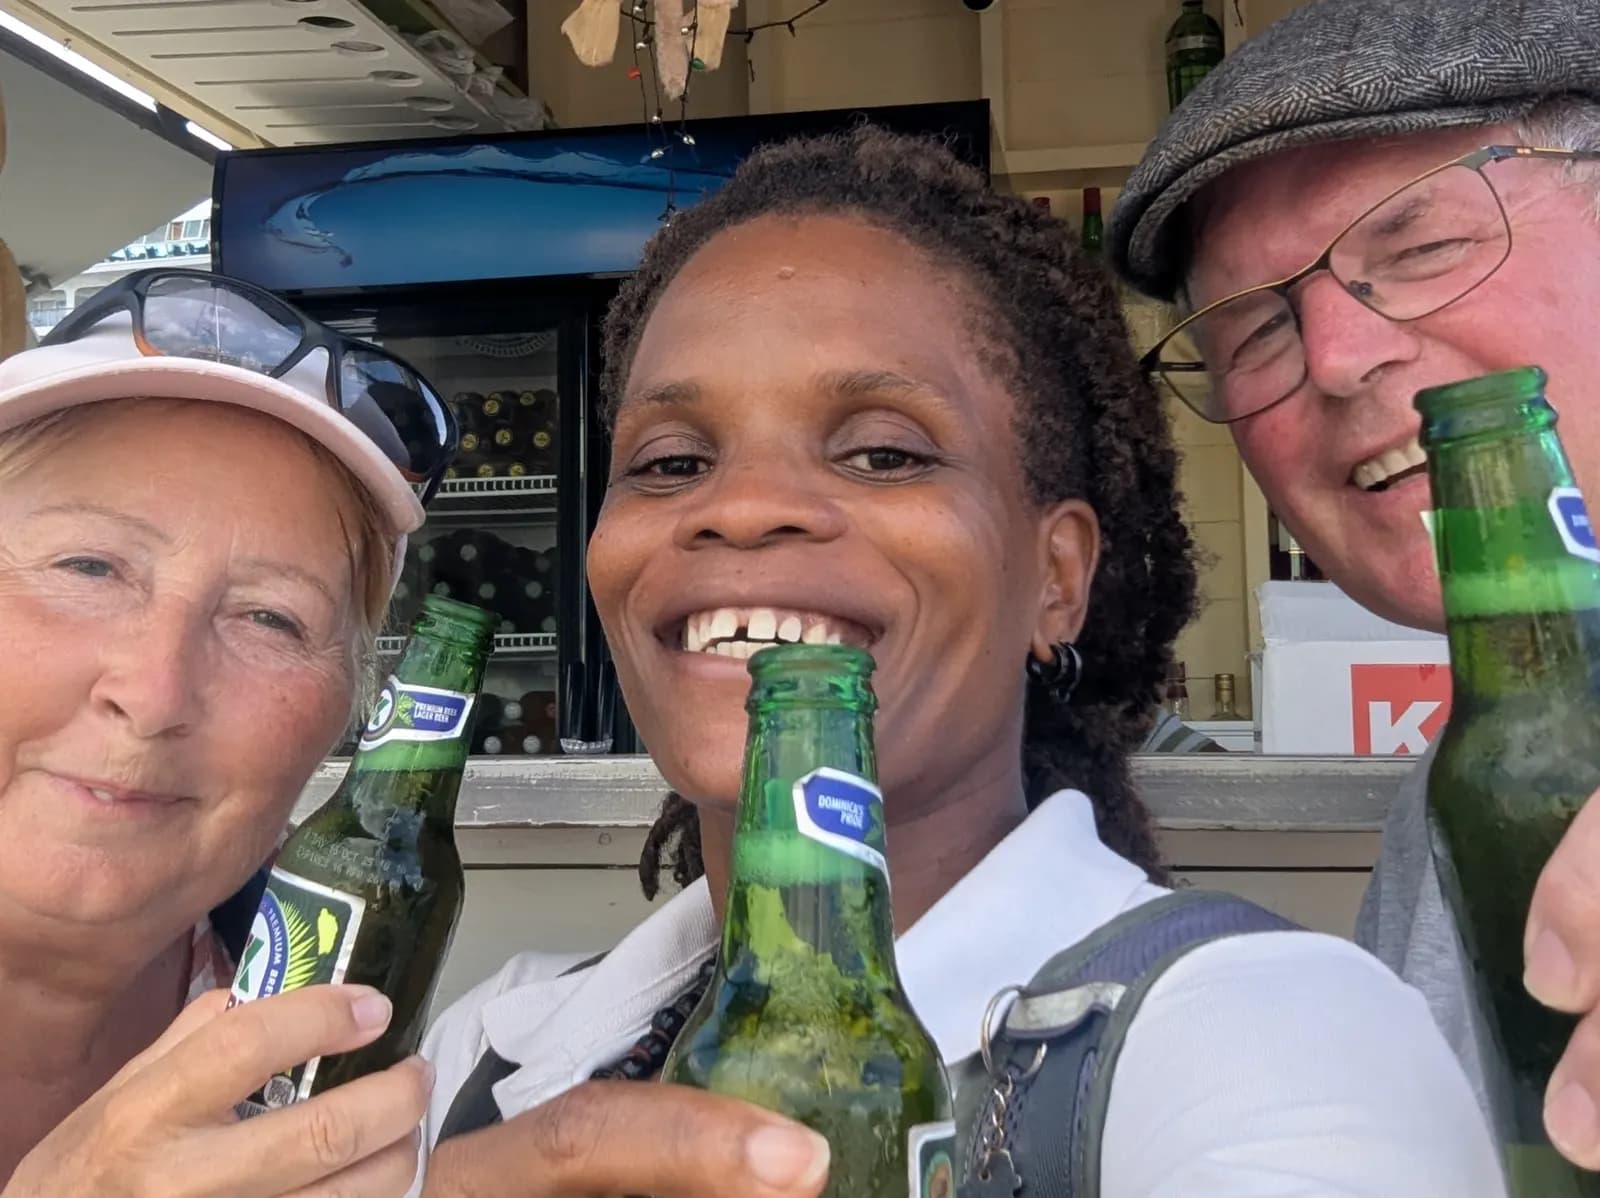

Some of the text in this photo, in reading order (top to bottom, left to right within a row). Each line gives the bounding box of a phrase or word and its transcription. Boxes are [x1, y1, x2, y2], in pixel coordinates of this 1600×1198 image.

[413, 708, 434, 721] LAGER
[1368, 701, 1442, 755] K
[818, 794, 865, 816] DOMINICA'S
[267, 908, 283, 966] PREMIUM
